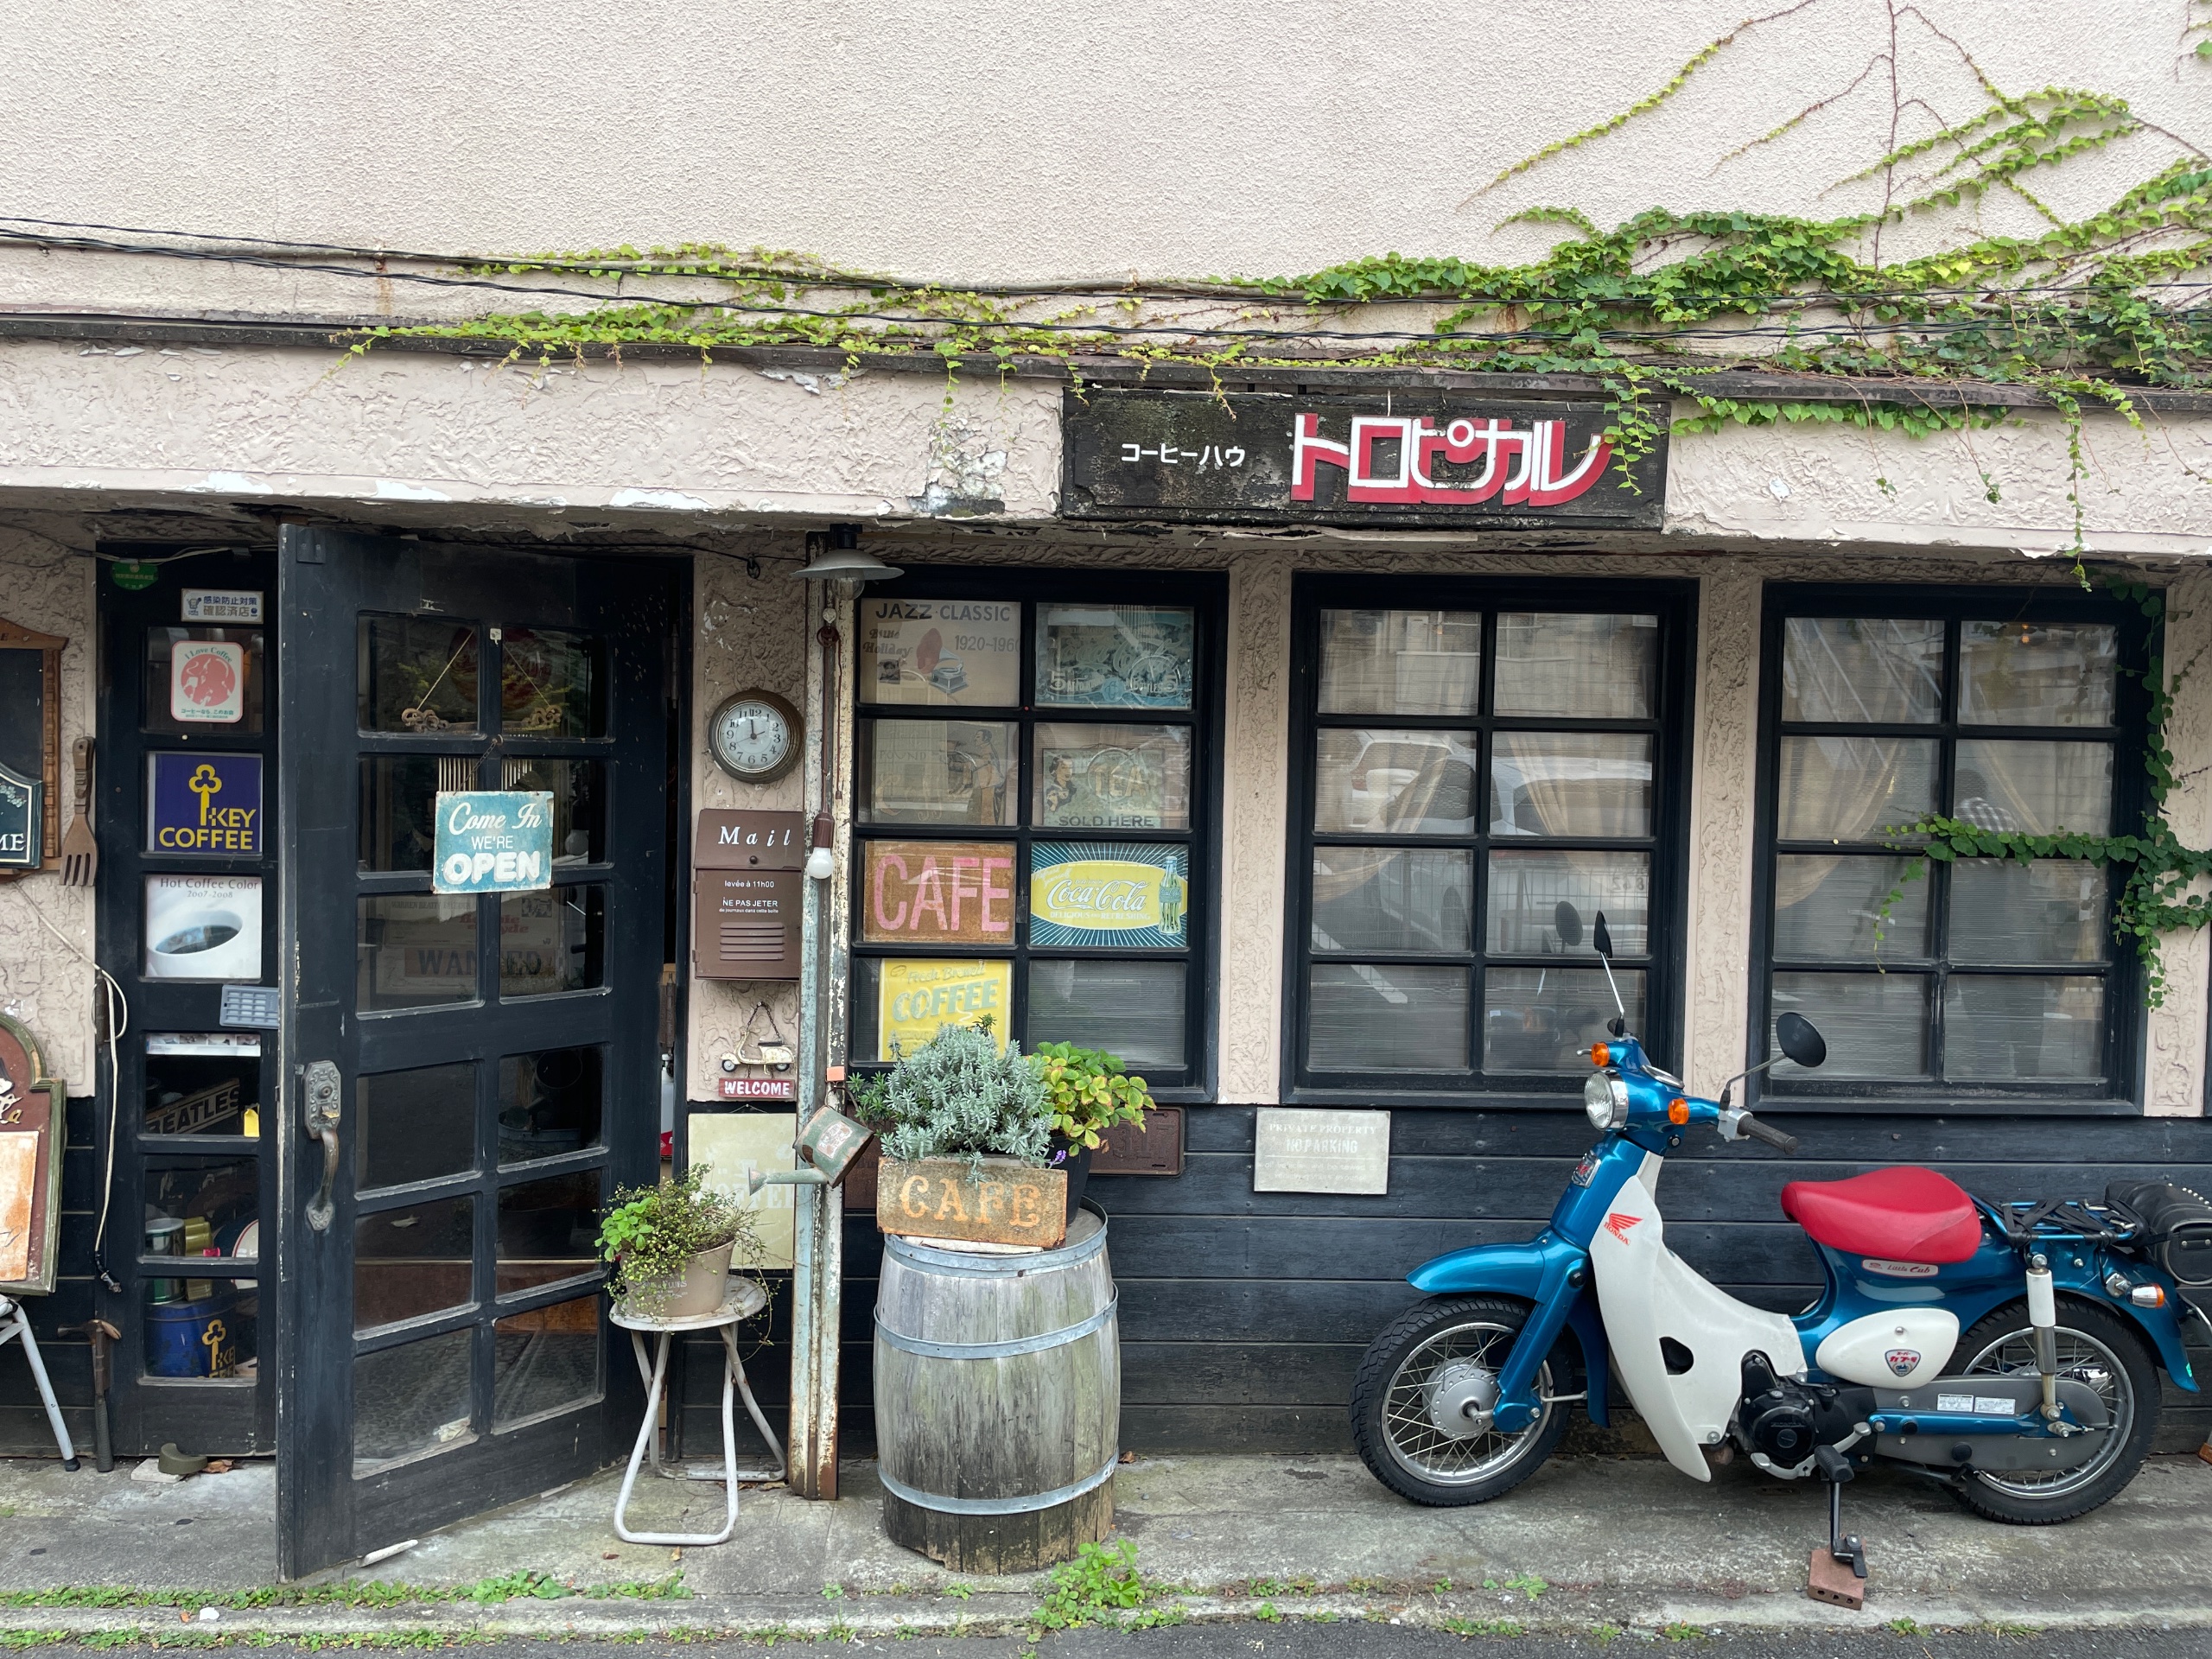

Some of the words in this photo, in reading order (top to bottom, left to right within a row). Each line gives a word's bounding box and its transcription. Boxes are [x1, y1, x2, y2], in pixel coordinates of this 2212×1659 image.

[1290, 413, 1614, 507] トロピカル
[204, 596, 257, 605] 感染防止対策
[203, 606, 250, 617] 確認済店
[875, 603, 932, 620] JAZZ
[939, 606, 1010, 621] CLASSIC
[190, 647, 209, 657] Love
[211, 646, 232, 663] Coffee
[727, 730, 734, 739] 9
[772, 722, 779, 732] 2
[729, 742, 736, 751] 8
[773, 734, 781, 743] 3
[737, 752, 743, 760] 7
[769, 745, 777, 754] 4
[747, 755, 756, 764] 6
[209, 807, 257, 828] KEY
[448, 802, 507, 836] Come
[512, 803, 543, 830] In
[1058, 816, 1103, 827] SOLD
[1109, 816, 1154, 827] HERE
[159, 827, 253, 850] COFFEE
[471, 836, 514, 849] WE'RE
[718, 825, 791, 847] Mail
[443, 850, 541, 885] OPEN
[160, 878, 181, 888] Hot
[186, 878, 225, 889] Coffee
[228, 879, 259, 889] Color
[187, 890, 233, 899] 2007-2008
[874, 855, 1011, 931] CAFE
[417, 948, 542, 976] WANED
[892, 980, 999, 1022] COFFEE
[724, 1080, 791, 1096] WELCOME
[1268, 1123, 1318, 1133] PRIVATE
[1319, 1124, 1377, 1135] PROPERTY
[1286, 1138, 1302, 1152] NO
[1303, 1138, 1359, 1154] PARKING
[899, 1174, 1042, 1227] CAFE
[1604, 1222, 1630, 1246] HONDA
